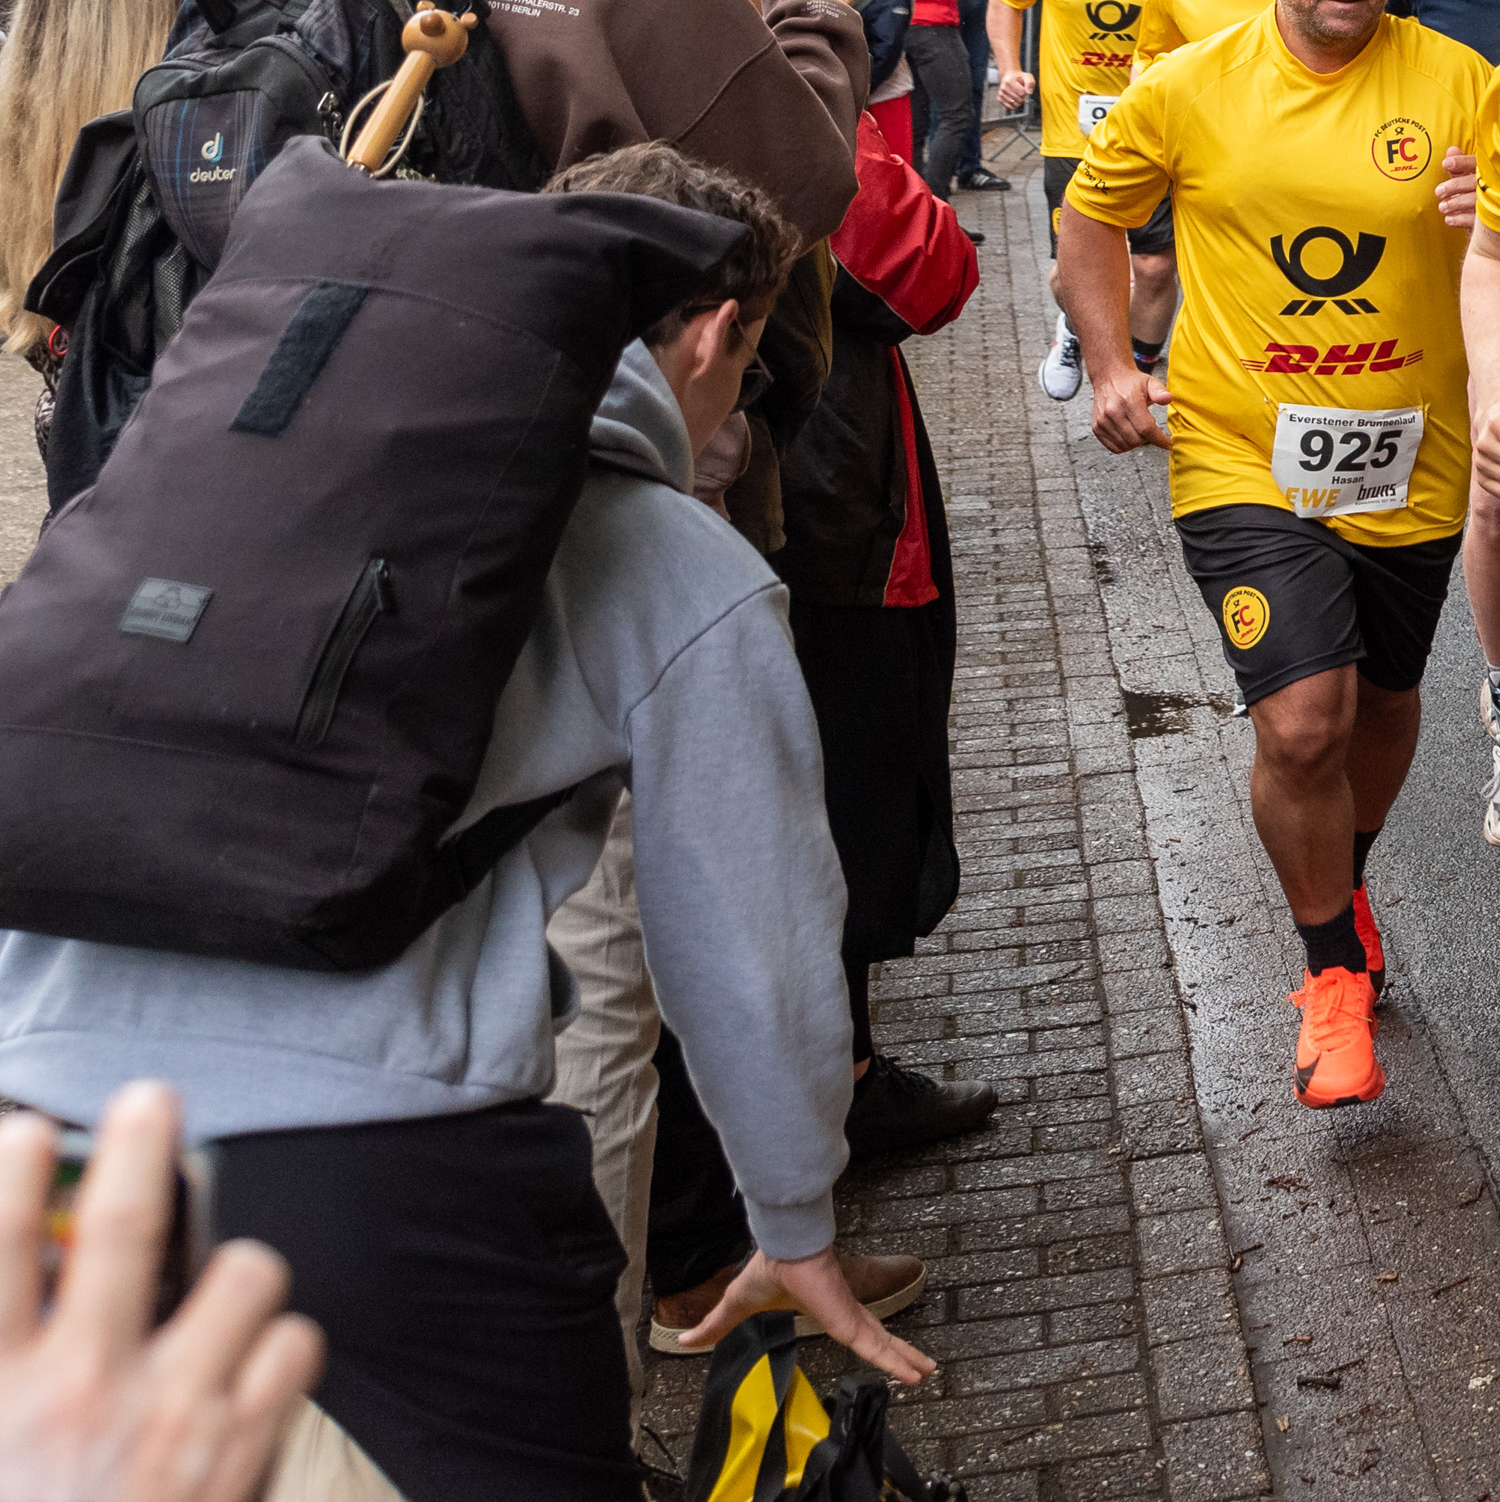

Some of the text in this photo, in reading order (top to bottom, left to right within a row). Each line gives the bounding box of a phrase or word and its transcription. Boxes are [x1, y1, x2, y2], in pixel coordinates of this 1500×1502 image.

[511, 5, 541, 17] BERLIN
[568, 7, 580, 16] 23
[1380, 117, 1410, 131] DEUTSCHE
[1411, 120, 1426, 132] POST
[1386, 137, 1418, 164] FC
[190, 166, 237, 183] deuter
[1264, 338, 1406, 376] DHL
[1289, 413, 1416, 427] Everstener Brunnenlauf
[1299, 429, 1403, 472] 925
[1331, 475, 1364, 485] Hasan
[1285, 483, 1397, 509] EWE bruns
[1231, 605, 1255, 633] FC
